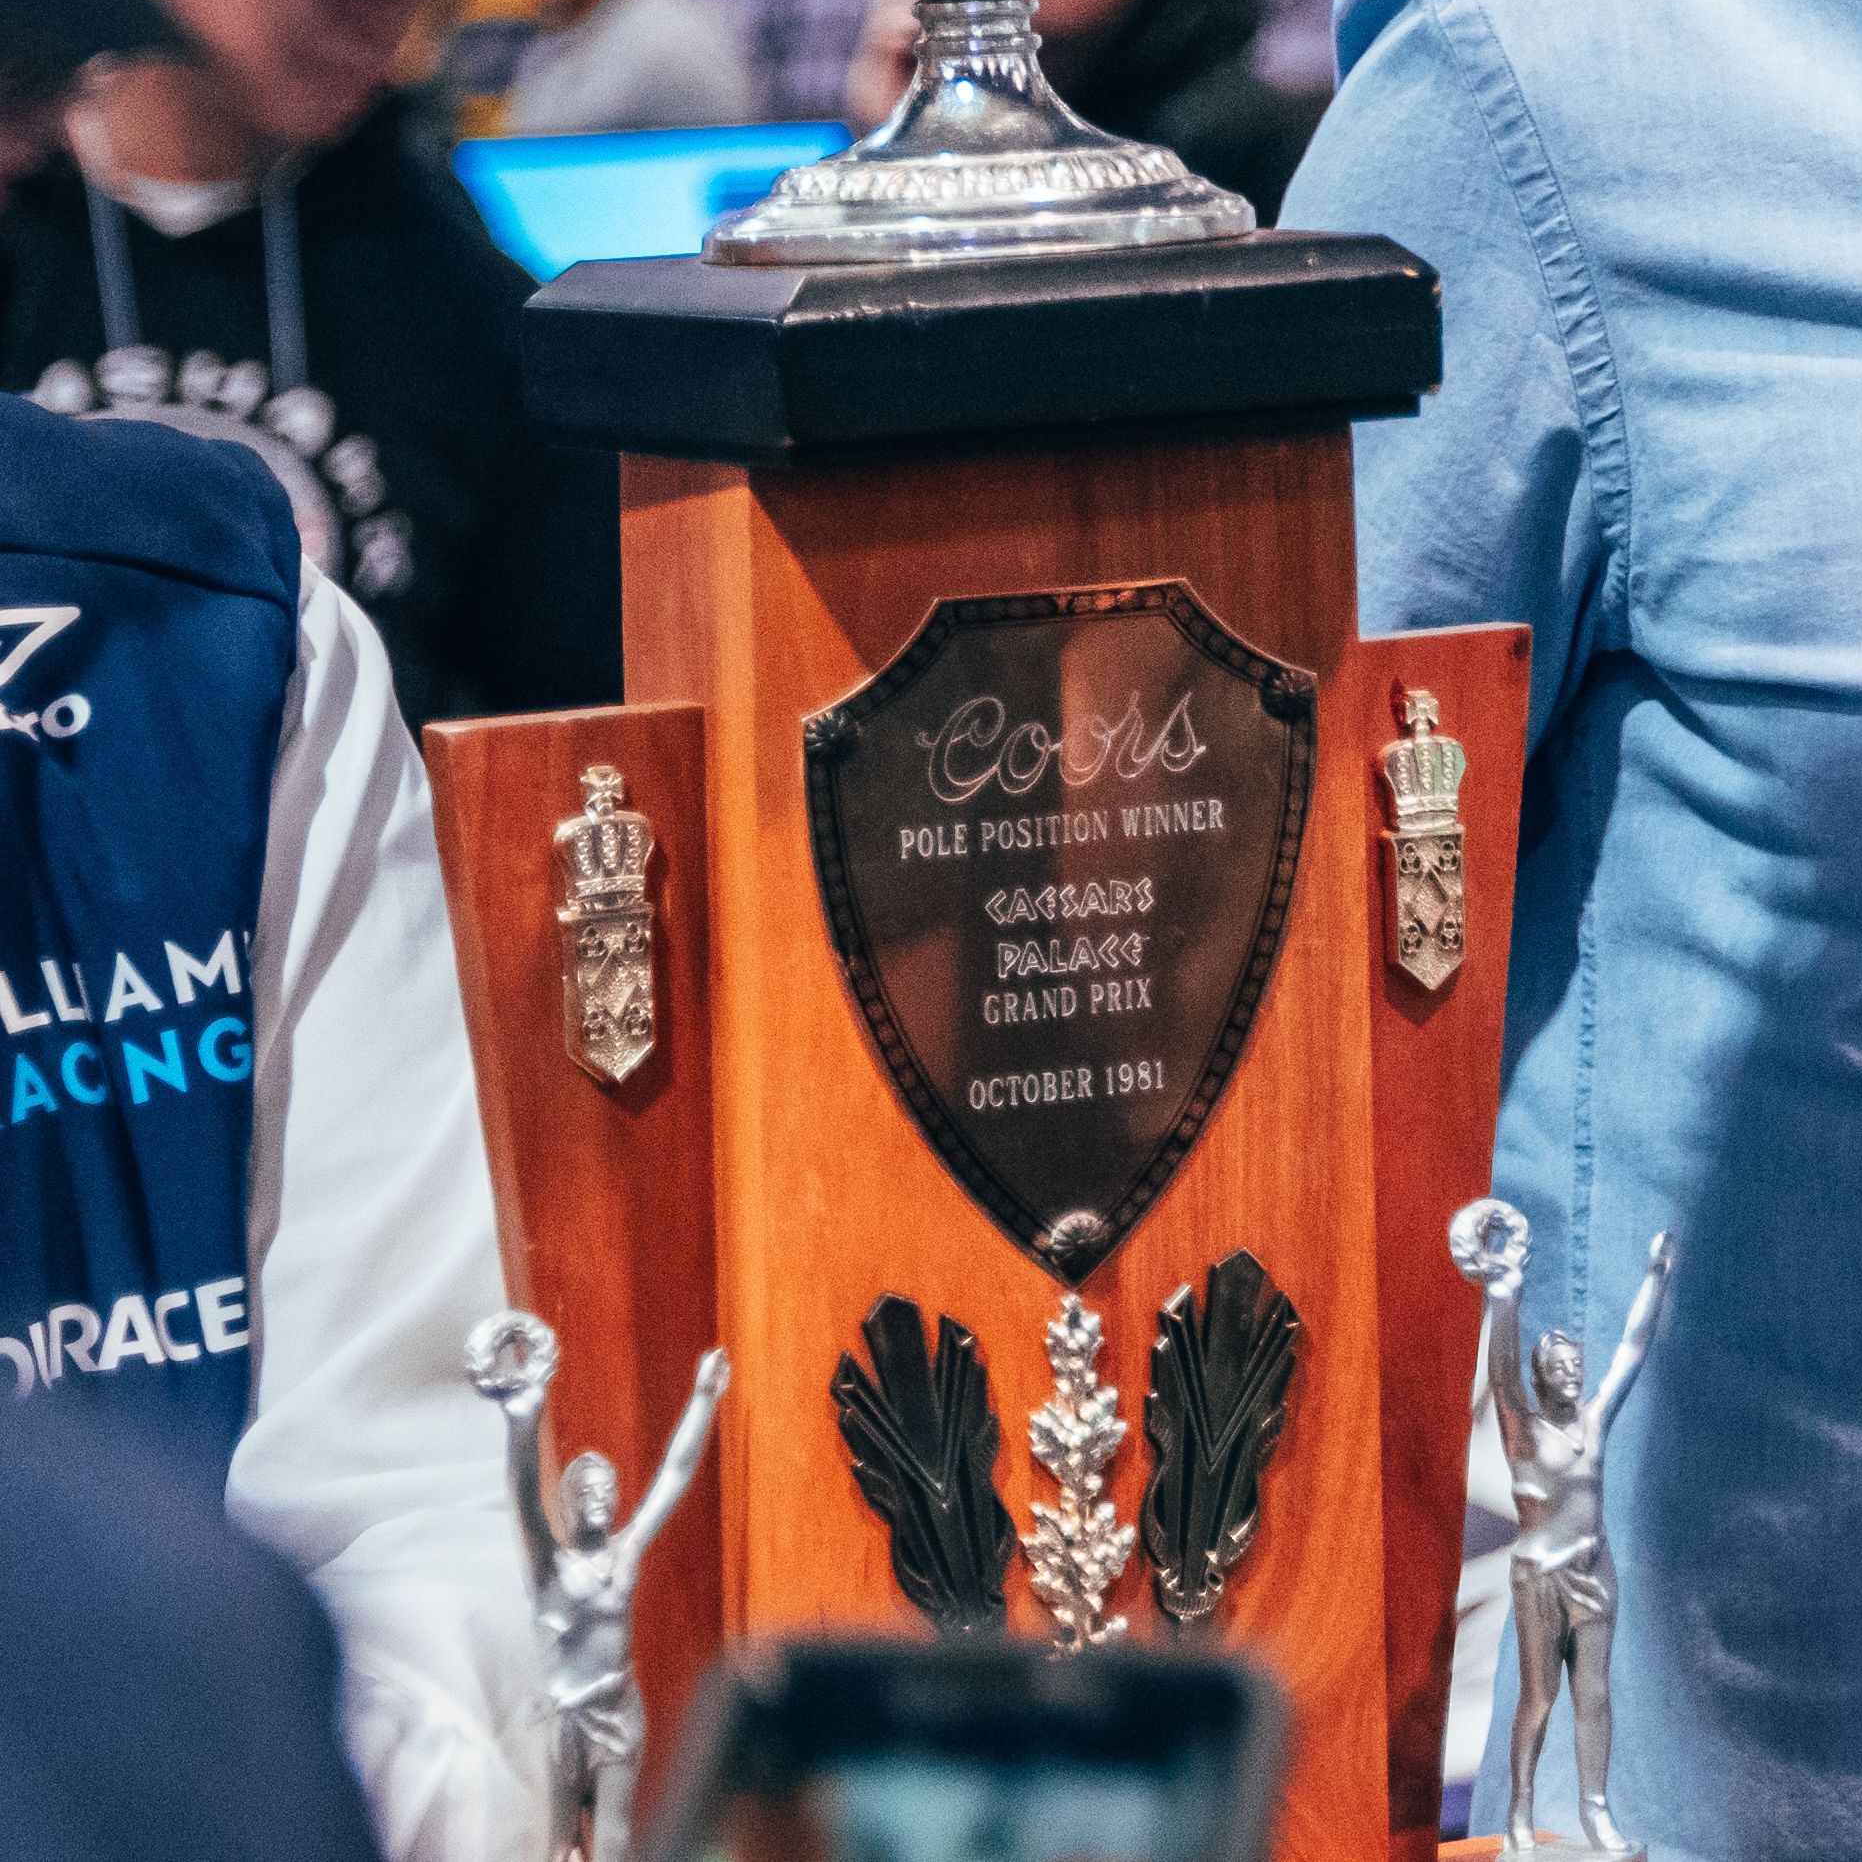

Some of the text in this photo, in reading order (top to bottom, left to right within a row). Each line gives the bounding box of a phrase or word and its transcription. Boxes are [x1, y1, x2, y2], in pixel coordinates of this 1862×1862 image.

[918, 686, 1206, 802] Coors
[899, 800, 1225, 859] POLE POSITION WINNER
[984, 877, 1155, 925] CAESARS
[996, 932, 1150, 978] PALACE
[983, 977, 1153, 1024] GRAND PRIX
[968, 1060, 1166, 1111] OCTOBER 1981
